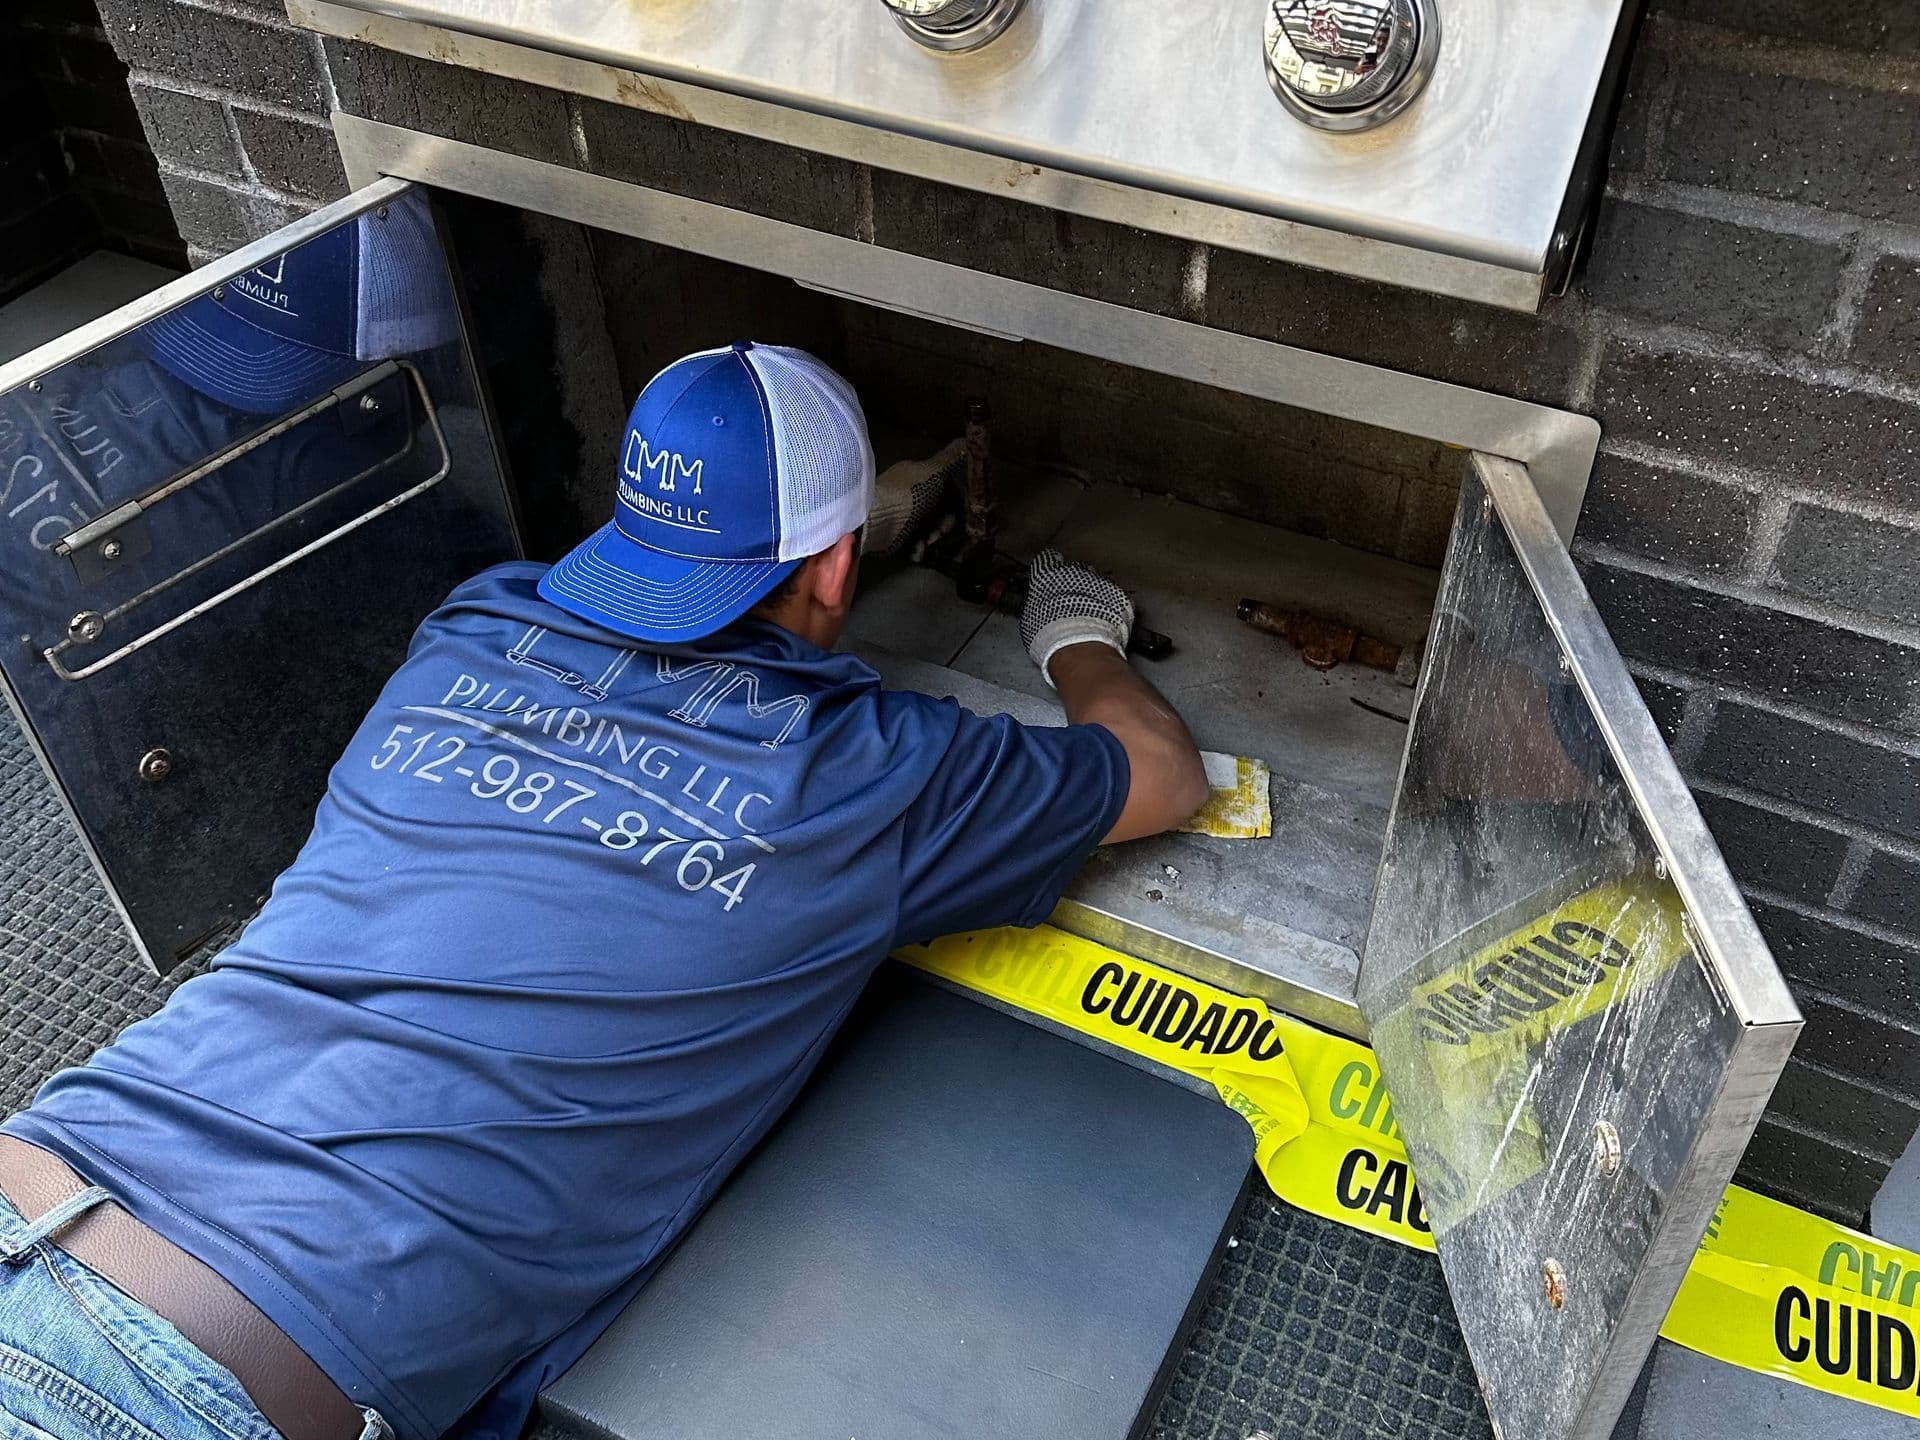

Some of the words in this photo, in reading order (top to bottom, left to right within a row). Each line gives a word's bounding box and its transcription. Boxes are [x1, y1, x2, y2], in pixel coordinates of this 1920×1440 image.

[618, 478, 673, 518] PLUMBING
[677, 505, 710, 525] LLC
[370, 725, 757, 912] 512-987-8764
[441, 673, 679, 778] PLUMBING
[681, 765, 773, 833] LLC
[1774, 1285, 1920, 1397] CUID
